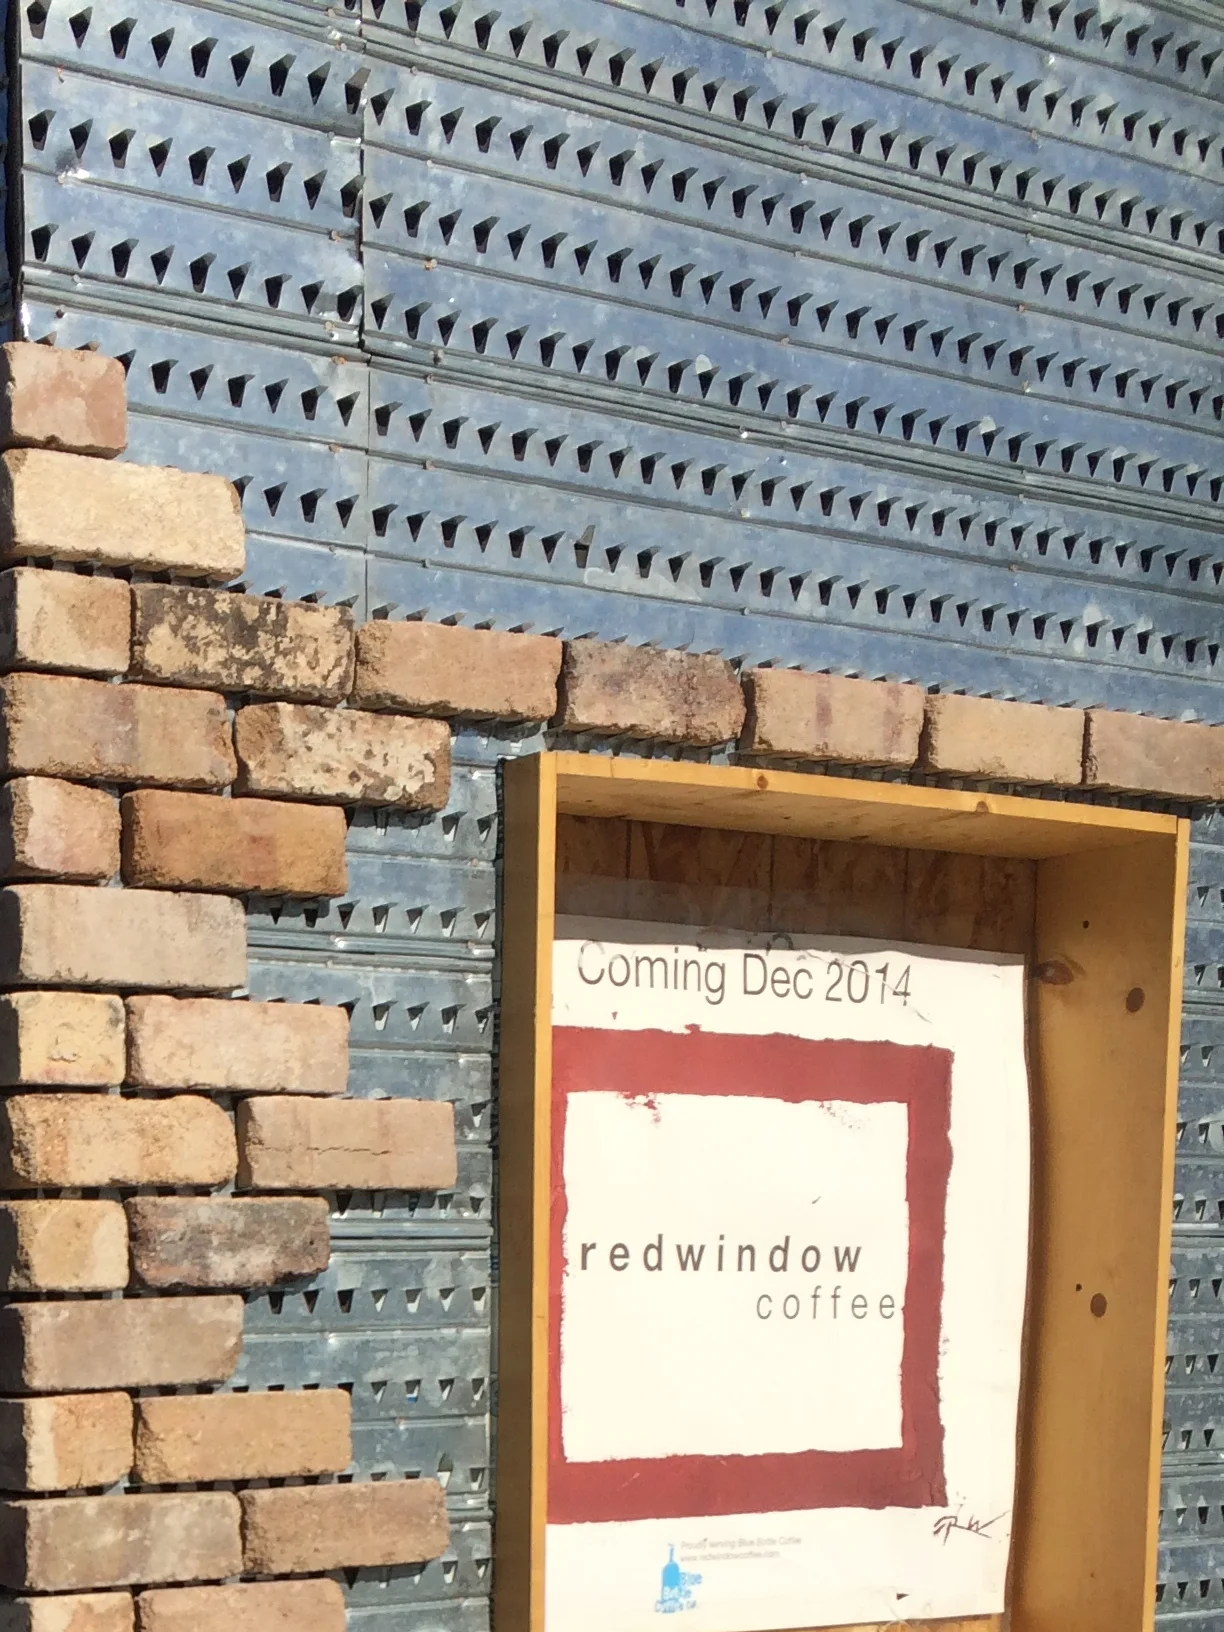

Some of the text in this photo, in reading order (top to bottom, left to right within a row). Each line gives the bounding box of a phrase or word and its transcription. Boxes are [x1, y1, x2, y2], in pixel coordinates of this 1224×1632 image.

[578, 939, 912, 1007] Coming Dec 2014
[580, 1233, 862, 1273] redwindow
[756, 1285, 896, 1320] coffee
